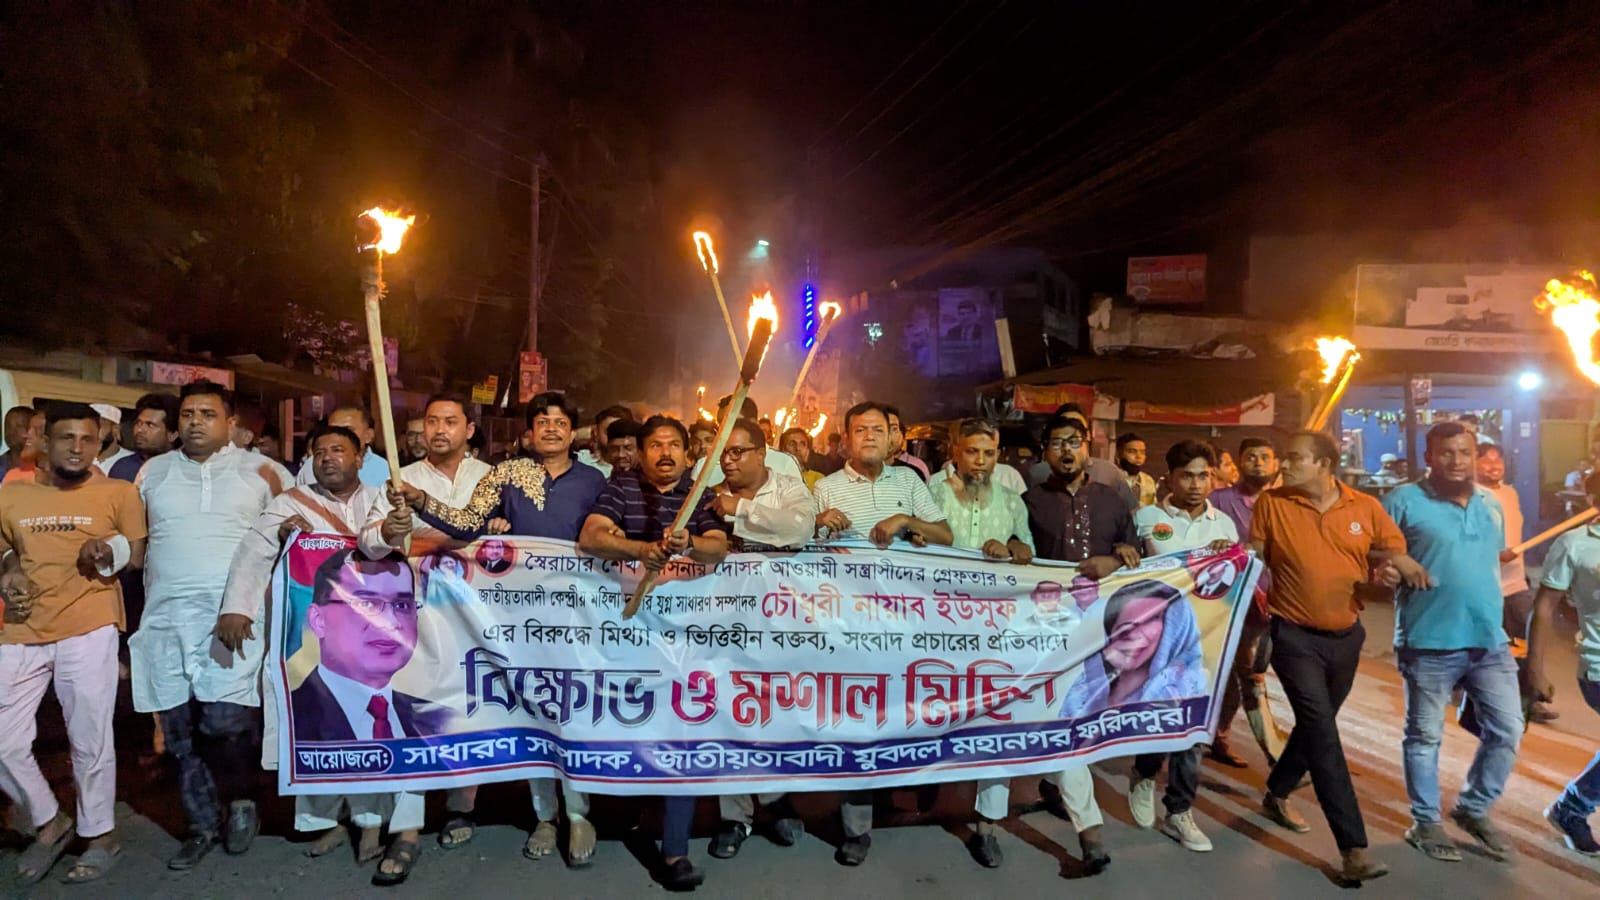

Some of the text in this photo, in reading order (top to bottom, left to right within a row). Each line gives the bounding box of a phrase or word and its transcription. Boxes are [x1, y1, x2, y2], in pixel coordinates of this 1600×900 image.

[524, 551, 594, 573] স্বৈরাচার
[714, 559, 764, 577] দোসর
[769, 556, 840, 579] আওয়ামী
[933, 567, 997, 587] গ্রেফতার
[1003, 574, 1018, 587] ও
[479, 583, 546, 609] জাতীয়তাবাদী
[590, 586, 622, 611] মহিলা
[676, 594, 712, 614] সাধারণ
[715, 594, 757, 613] সম্পাদক
[761, 583, 844, 623] চৌধুরী
[851, 591, 926, 623] নায়াব
[933, 588, 1018, 630] ইউসুফ
[483, 618, 1070, 655] এর বিরুদ্ধে মিথ্যা ও ভিত্তিহীন বক্তব্য, সংবাদ প্রচারের প্রতিবাদে
[460, 647, 662, 727] বিক্ষোভ
[671, 669, 719, 726] ও
[729, 670, 892, 730] মশাল
[402, 737, 518, 765] সাধারণ
[653, 742, 845, 771] জাতীয়তাবাদী
[853, 739, 944, 771] যুবদল
[951, 728, 1074, 756] মহানগর
